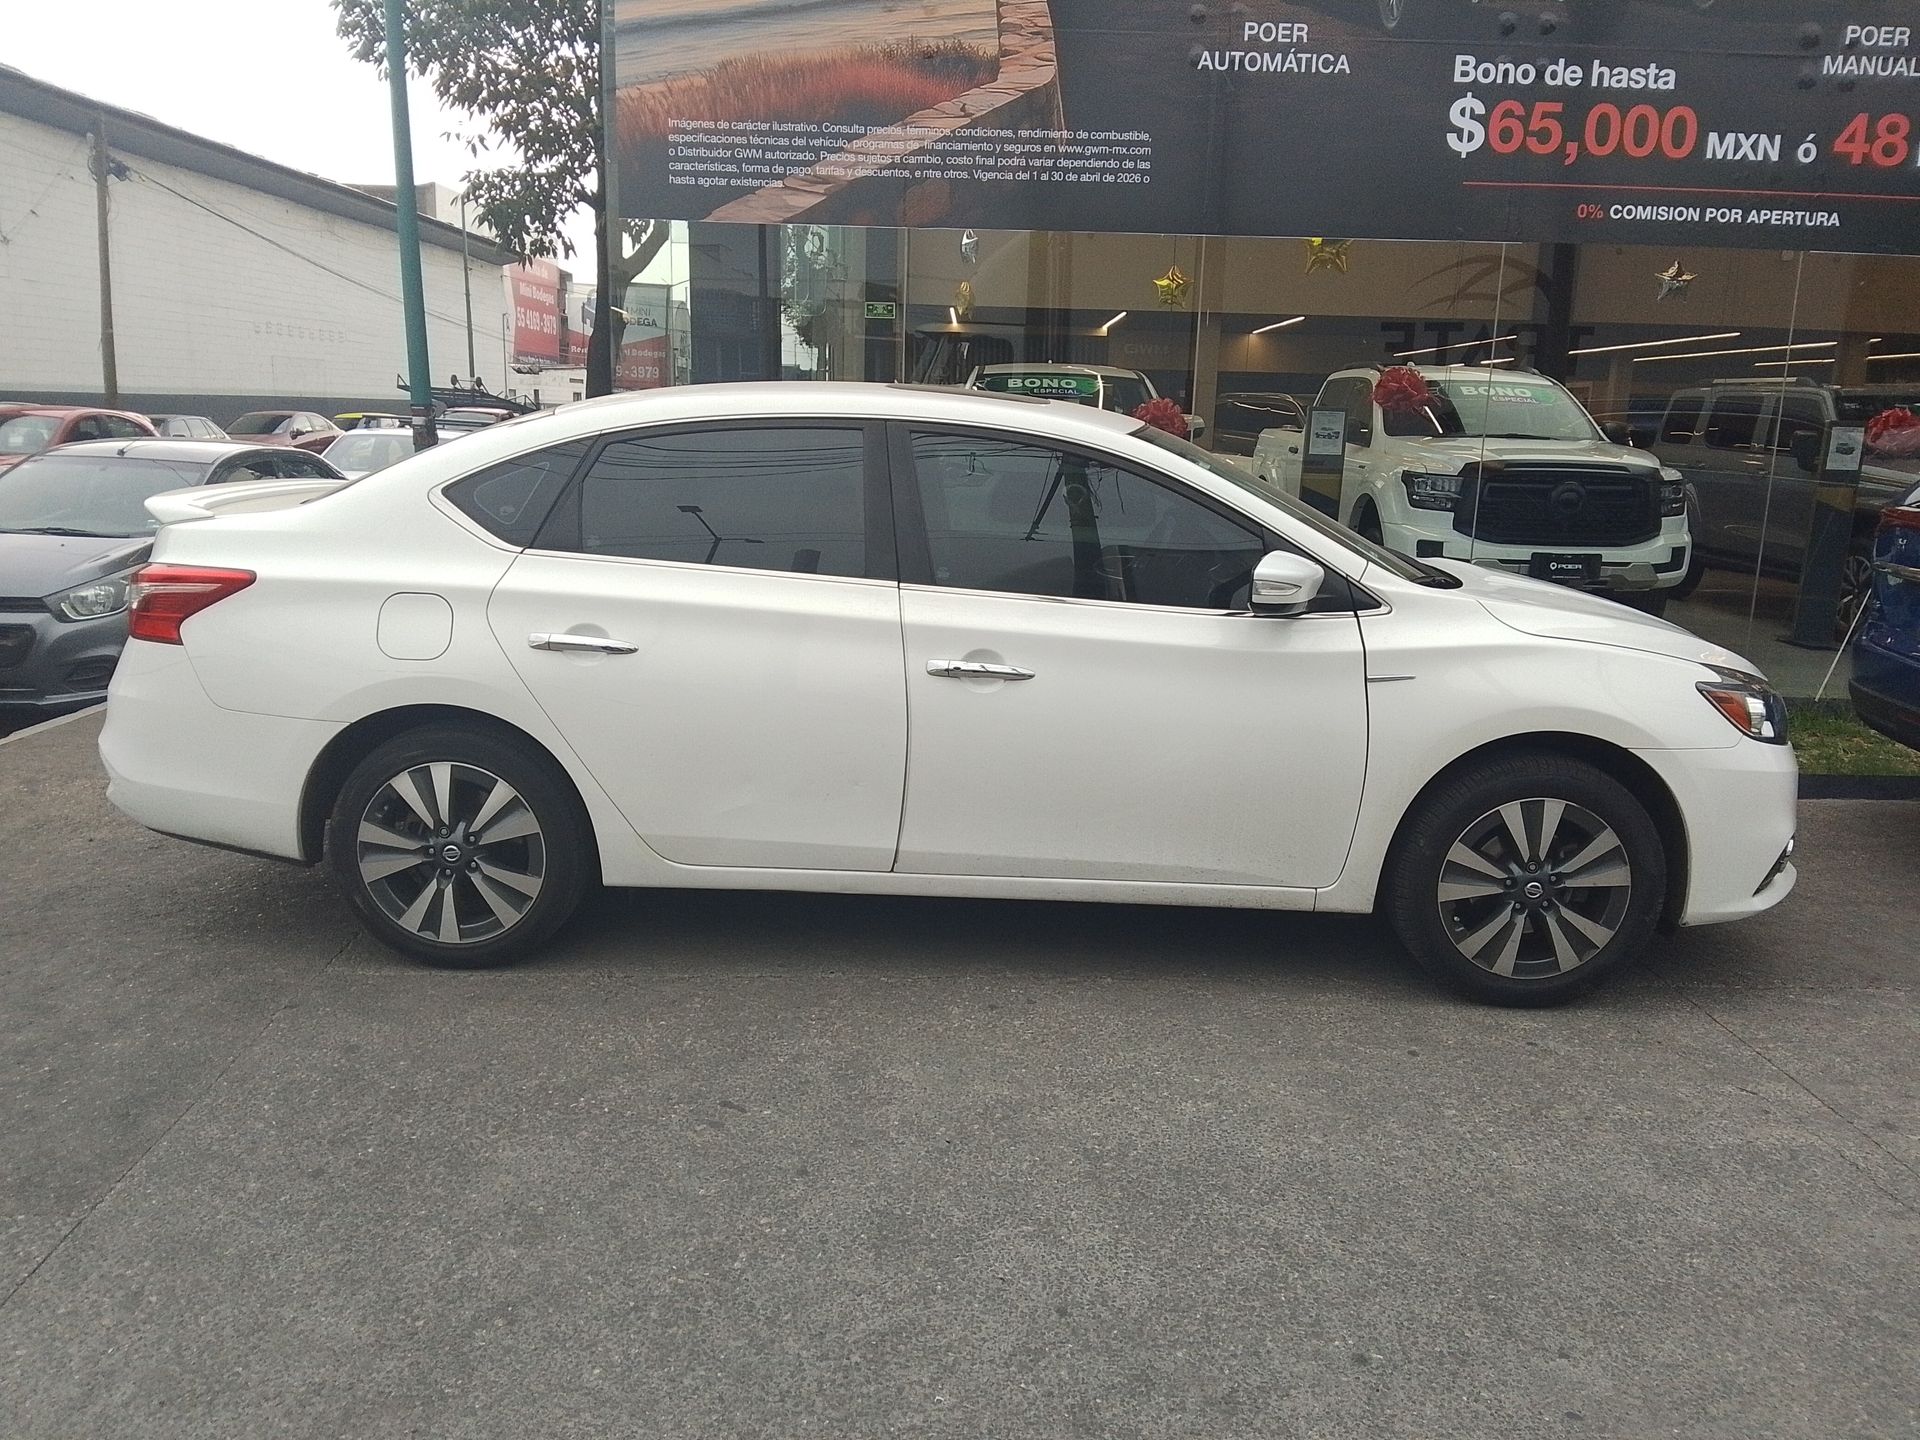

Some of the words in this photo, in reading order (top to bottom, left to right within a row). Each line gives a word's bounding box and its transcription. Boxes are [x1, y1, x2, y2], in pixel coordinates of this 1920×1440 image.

[1243, 22, 1308, 43] POER
[1845, 25, 1911, 47] POER
[1197, 48, 1351, 74] AUTOMÁTICA
[1822, 55, 1920, 77] MANUAL
[1453, 54, 1533, 86] Bono
[1544, 56, 1583, 87] de
[1591, 59, 1677, 91] hasta
[669, 118, 714, 131] Imágenes
[717, 120, 729, 130] de
[731, 121, 770, 131] carácter
[772, 121, 820, 132] ilustrativo.
[822, 123, 864, 133] Consulta
[867, 126, 905, 136] precios,
[906, 124, 953, 137] términos,
[956, 127, 1015, 138] condiciones,
[1018, 128, 1074, 139] rendimiento
[1076, 130, 1088, 139] de
[1091, 130, 1151, 142] combustible,
[1446, 93, 1699, 165] $65,000
[1706, 132, 1781, 162] MXN
[1797, 133, 1817, 163] ó
[1833, 112, 1910, 166] 48
[669, 134, 747, 148] especificaciones
[750, 135, 789, 146] técnicas
[792, 136, 806, 146] del
[809, 137, 850, 148] vehículo,
[853, 140, 904, 150] programas
[925, 140, 993, 151] financiamiento
[996, 143, 1001, 153] y
[1004, 143, 1040, 154] seguros
[1044, 144, 1055, 152] en
[1058, 144, 1151, 156] www.gwm-mx.com
[678, 147, 731, 158] Distribuidor
[735, 149, 762, 158] GWM
[765, 149, 817, 160] autorizado.
[821, 151, 855, 162] Precios
[858, 153, 892, 164] sujetos
[895, 155, 900, 163] a
[902, 152, 944, 166] cambio,
[946, 156, 973, 165] costo
[976, 155, 994, 165] final
[998, 156, 1026, 167] podrá
[1028, 157, 1054, 166] variar
[1057, 157, 1119, 169] dependiendo
[1122, 159, 1134, 169] de
[1137, 159, 1150, 169] las
[669, 161, 739, 173] características,
[742, 163, 769, 173] forma
[772, 164, 784, 173] de
[787, 166, 813, 176] pago,
[816, 165, 844, 176] tarifas
[847, 168, 852, 178] y
[855, 167, 912, 179] descuentos,
[944, 170, 970, 179] otros.
[973, 169, 1013, 181] Vigencia
[1015, 170, 1030, 180] del
[1033, 171, 1037, 180] 1
[1040, 171, 1048, 181] al
[1051, 171, 1063, 181] 30
[1065, 172, 1078, 181] de
[1080, 172, 1100, 182] abril
[1103, 172, 1115, 182] de
[1117, 173, 1140, 183] 2026
[1144, 175, 1149, 183] o
[669, 174, 695, 184] hasta
[698, 175, 727, 188] agotar
[730, 177, 784, 188] existencias.
[1577, 204, 1604, 219] 0%
[1609, 204, 1699, 223] COMISION
[1705, 208, 1743, 225] POR
[1747, 209, 1841, 227] APERTURA
[519, 281, 533, 299] Mini
[532, 286, 555, 306] Bodegas
[516, 306, 526, 328] 55
[1007, 378, 1077, 388] BONO
[1460, 386, 1532, 398] BONO
[1493, 396, 1539, 404] ESPECIAL
